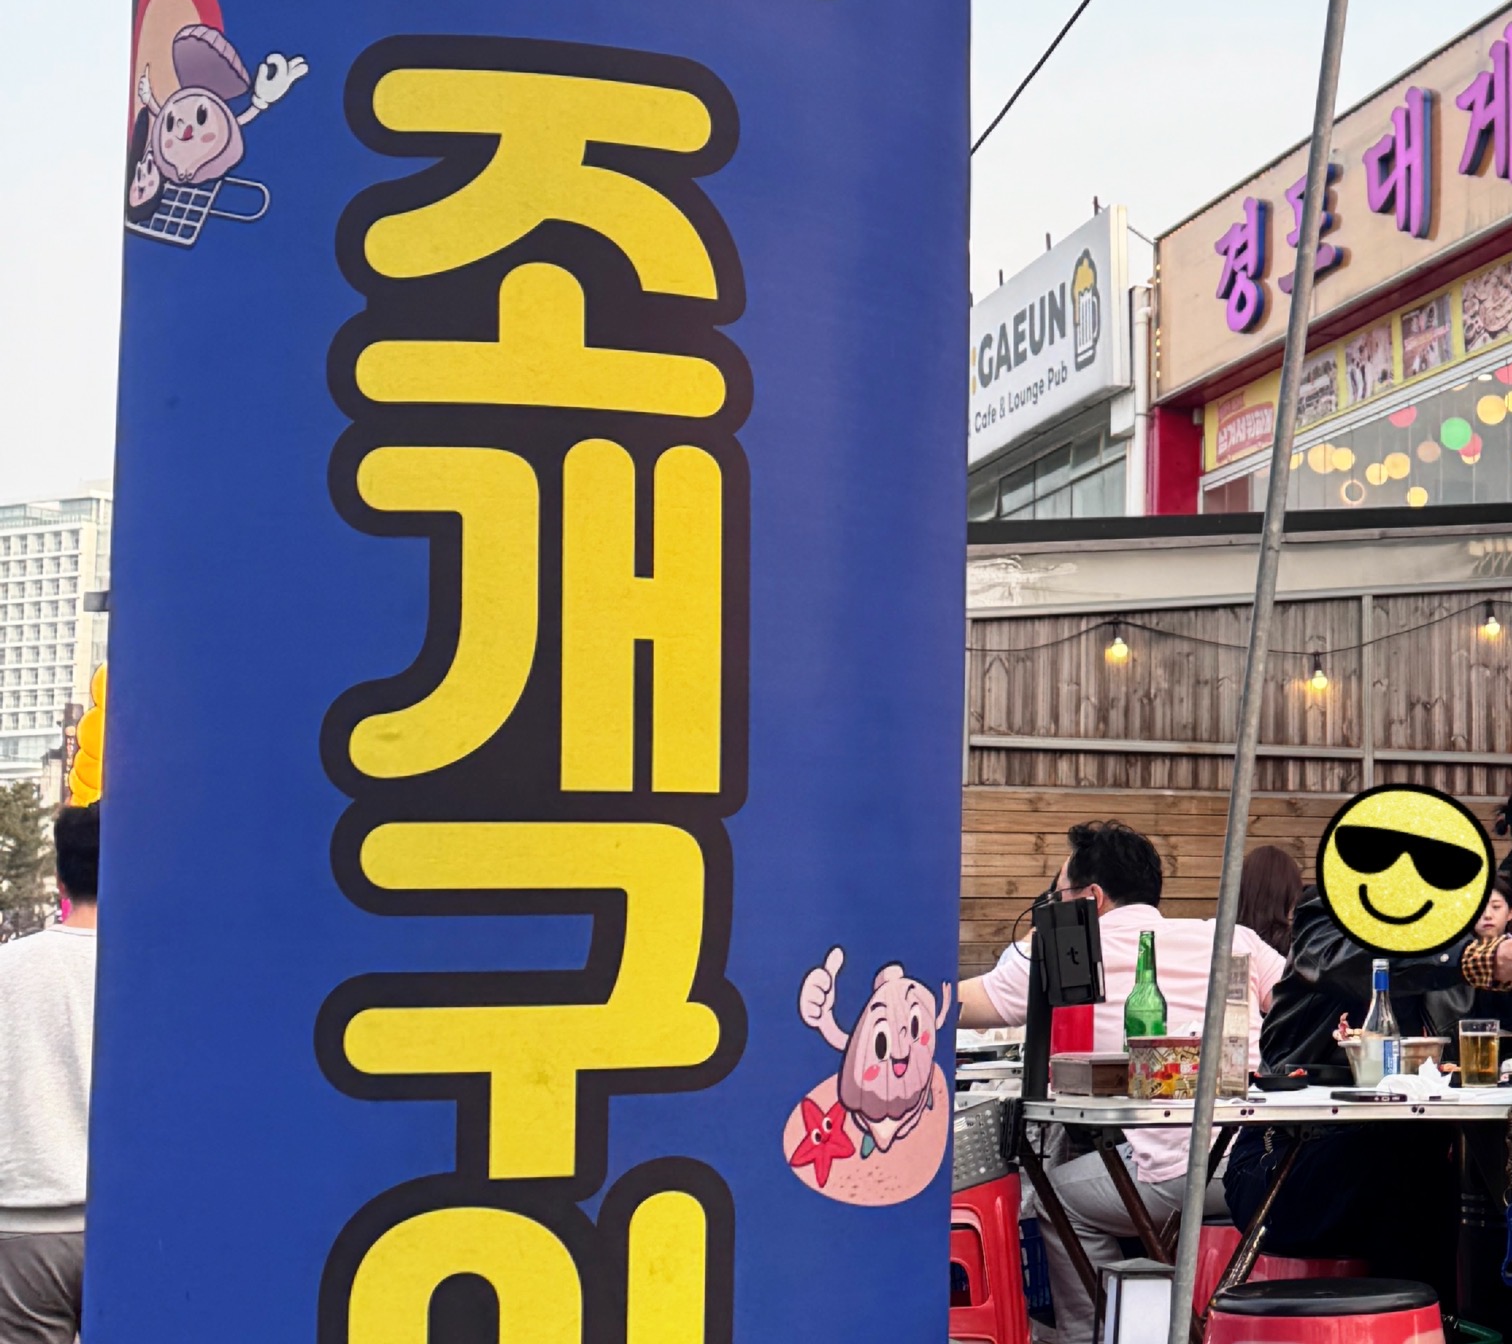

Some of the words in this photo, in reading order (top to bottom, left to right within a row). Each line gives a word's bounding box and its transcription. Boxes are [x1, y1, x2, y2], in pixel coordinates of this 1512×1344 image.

[974, 403, 997, 434] Cafe
[1008, 378, 1045, 414] Lounge
[1047, 360, 1069, 389] Pub
